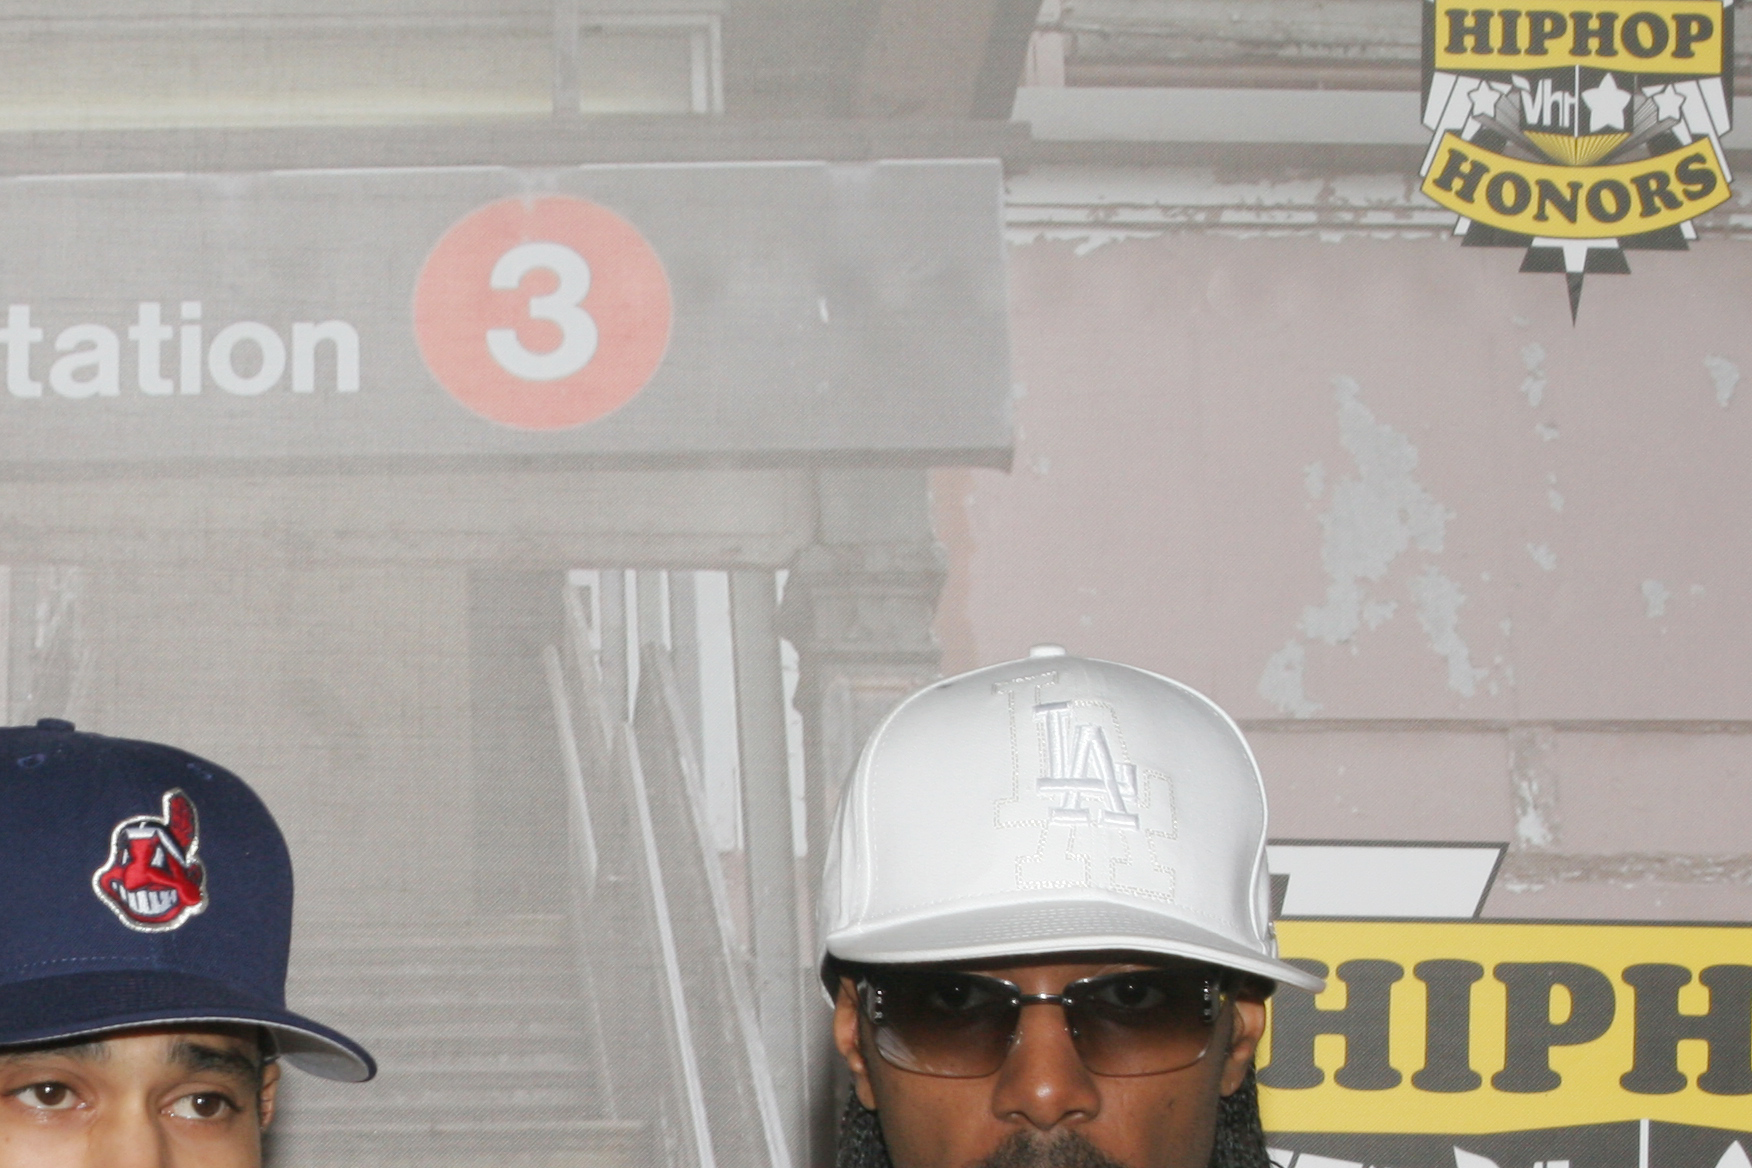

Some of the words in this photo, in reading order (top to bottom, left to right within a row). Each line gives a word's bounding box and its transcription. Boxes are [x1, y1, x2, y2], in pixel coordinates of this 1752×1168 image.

[1444, 9, 1714, 59] HIPHOP
[1432, 149, 1718, 224] HONORS
[486, 242, 599, 381] 3
[1034, 700, 1141, 831] LA
[1256, 957, 1752, 1095] HIPH
